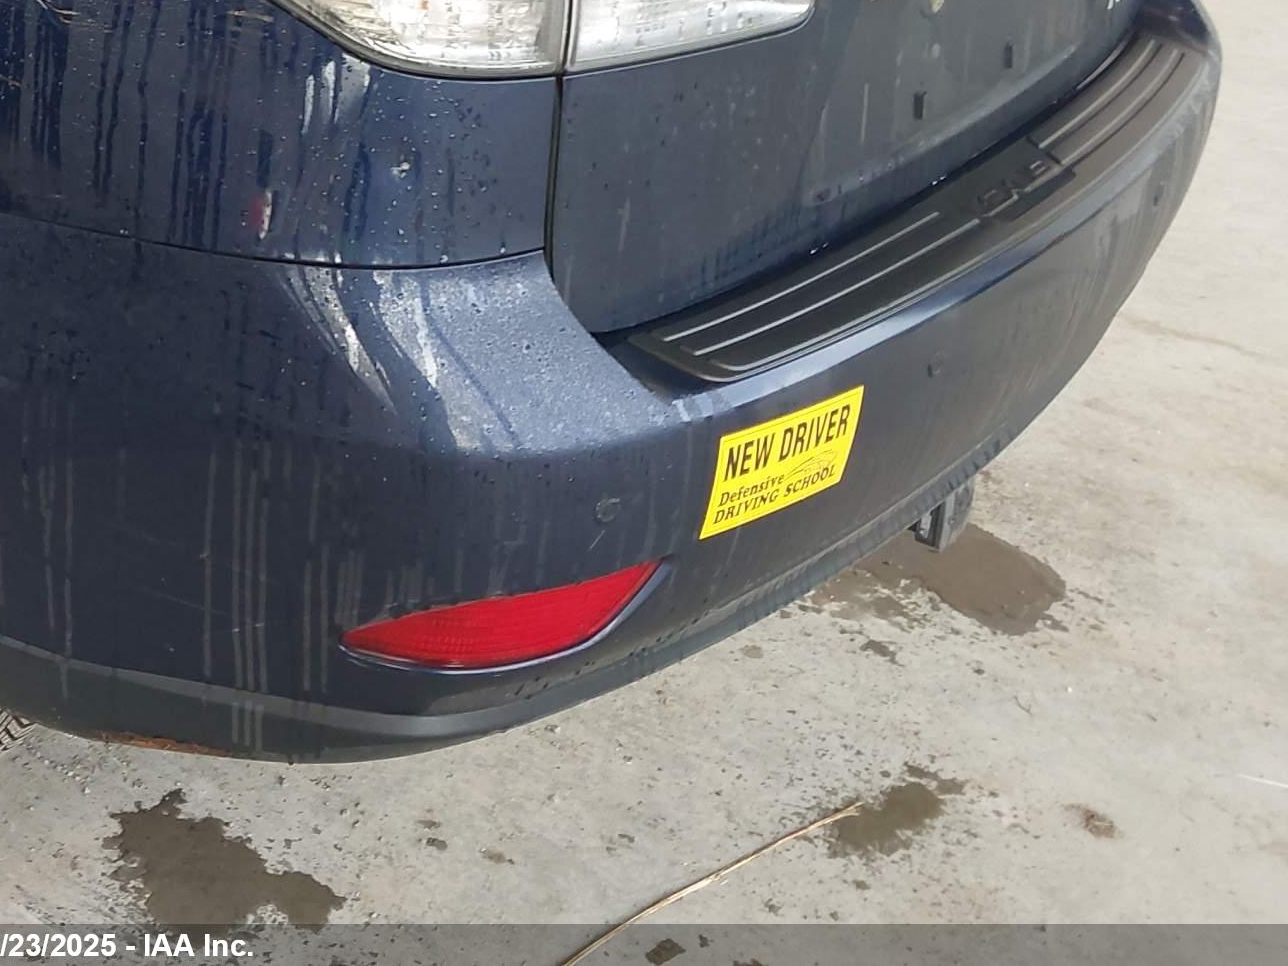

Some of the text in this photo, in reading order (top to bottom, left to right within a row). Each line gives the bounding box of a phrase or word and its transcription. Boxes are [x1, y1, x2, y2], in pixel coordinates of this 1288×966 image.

[724, 404, 851, 482] NEW DRIVER
[713, 464, 836, 524] DRIVING SCHOOL
[718, 474, 785, 507] Defensive
